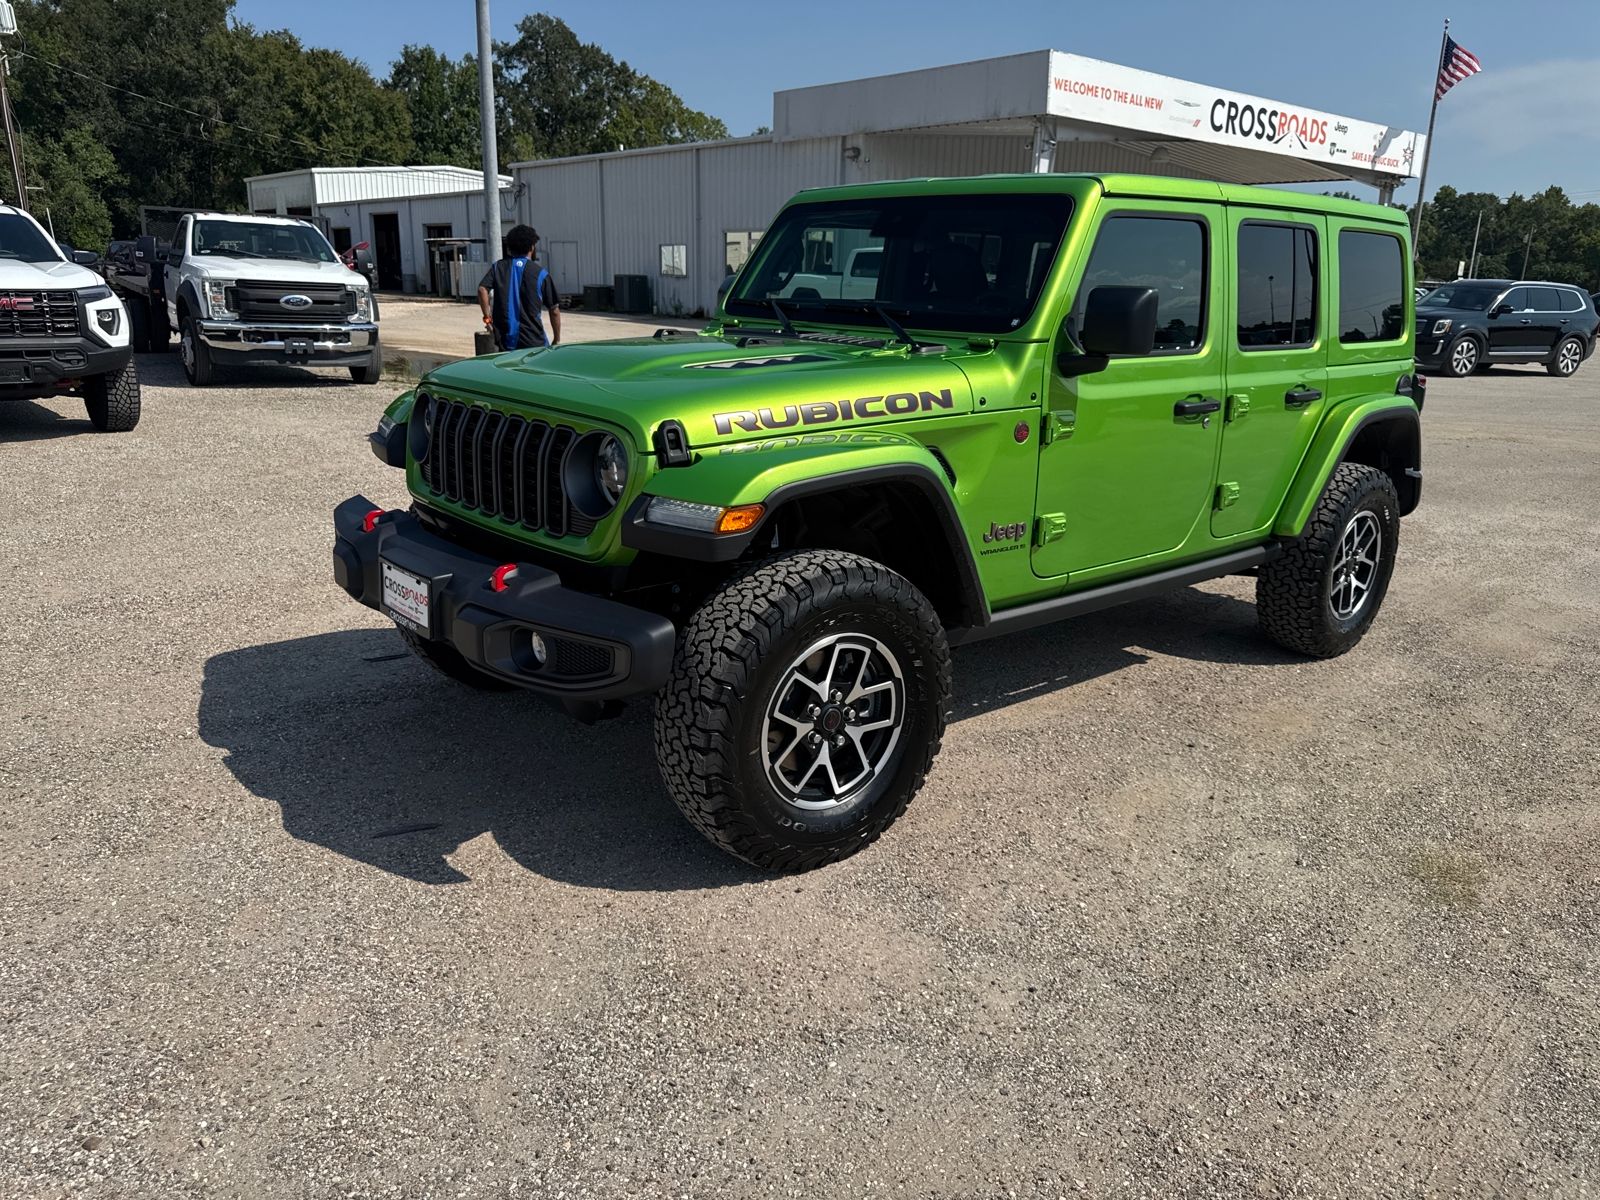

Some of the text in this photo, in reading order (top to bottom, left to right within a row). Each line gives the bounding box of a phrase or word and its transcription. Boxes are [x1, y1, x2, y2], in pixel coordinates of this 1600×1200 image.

[1054, 77, 1163, 111] WELCOME TO THE ALL NEW
[1210, 98, 1328, 146] CROSSROADS
[1335, 121, 1348, 135] Jeep
[0, 297, 34, 311] MC
[712, 388, 954, 436] RUBICON
[983, 521, 1026, 543] Jeep
[980, 545, 1019, 556] WRANGLER
[384, 575, 429, 607] CROSSROADS
